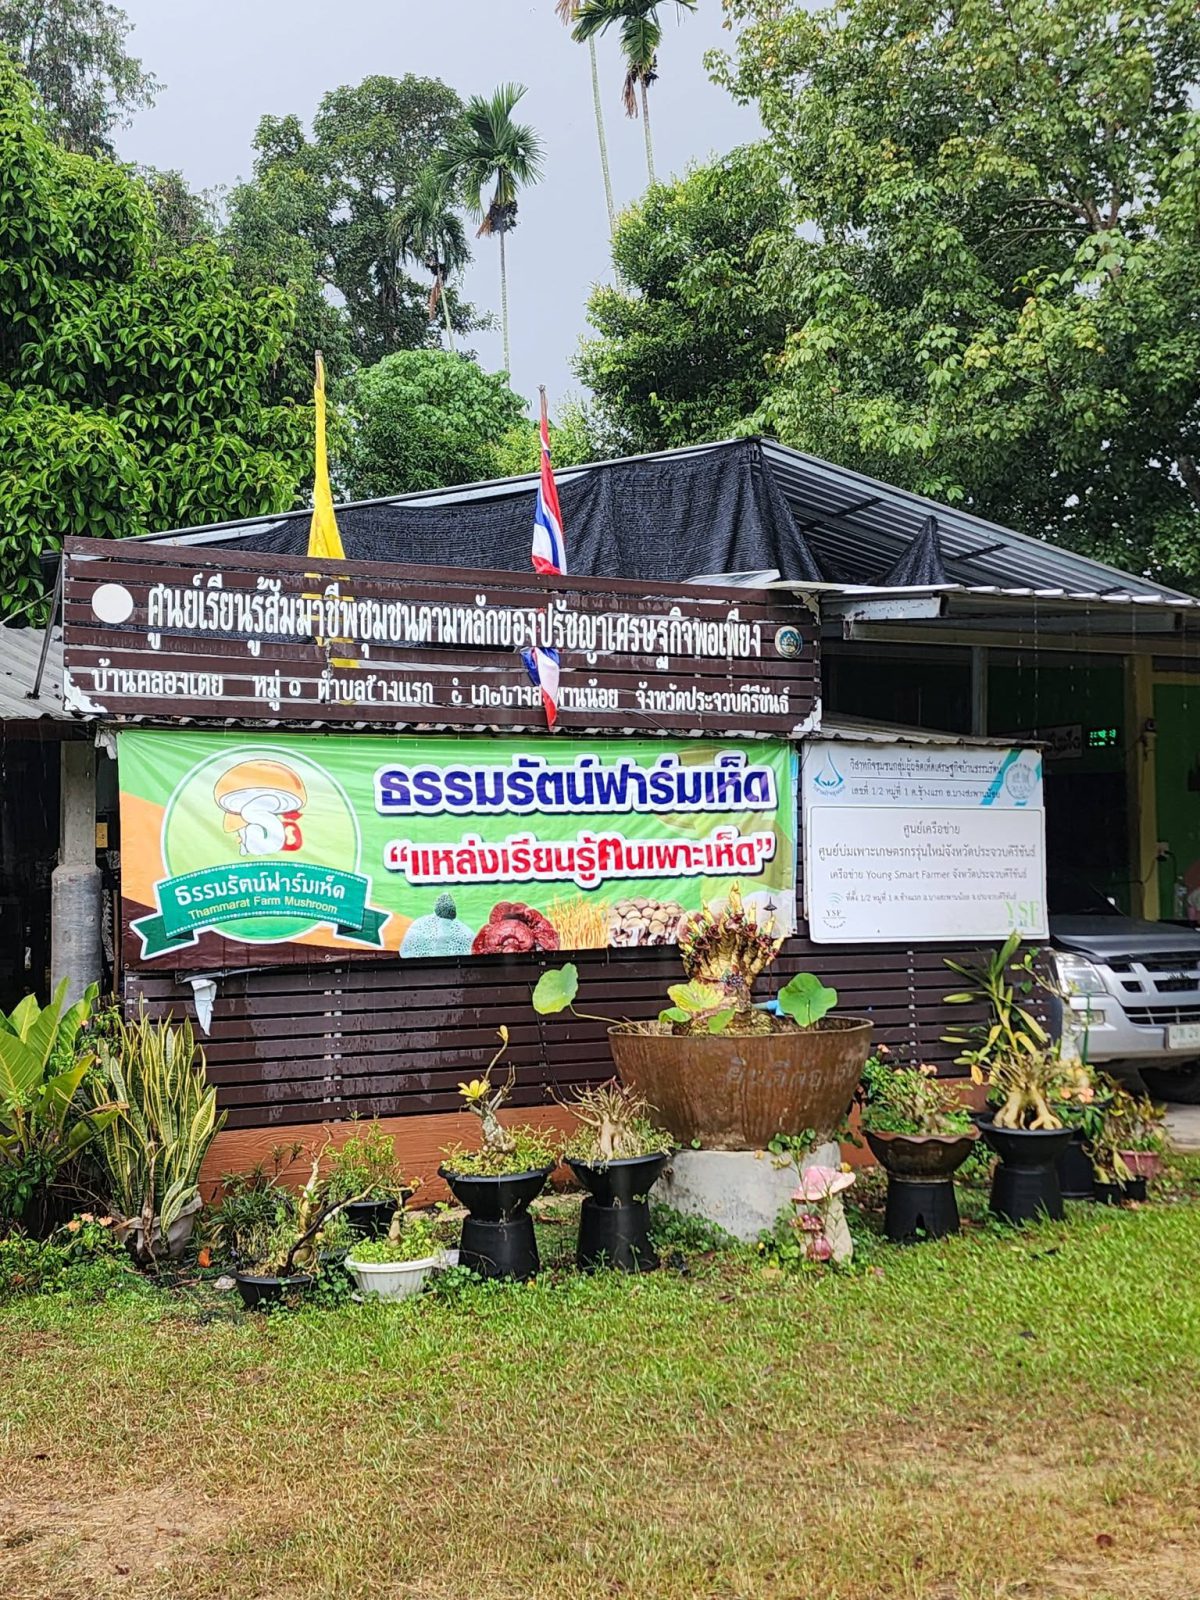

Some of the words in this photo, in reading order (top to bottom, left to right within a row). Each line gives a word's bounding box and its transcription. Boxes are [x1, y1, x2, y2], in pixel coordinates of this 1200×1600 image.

[91, 658, 224, 697] บ้านคลองเตย
[252, 669, 281, 711] หมู่
[635, 681, 790, 714] จังหวัดประจวบคีรีขันธ์
[380, 754, 773, 806] ธรรมรัตน์ฟาร์มเห็ด
[903, 820, 960, 838] ศูนย์เครือข่าย
[174, 871, 345, 906] ธรรมรัตน์ฟาร์มเห็ด
[830, 867, 864, 879] เครือข่าย
[866, 870, 892, 881] Young
[894, 870, 919, 879] Smart
[921, 870, 950, 879] Farmer
[187, 899, 250, 920] Thammarat
[253, 895, 281, 906] Farm
[284, 895, 338, 914] Mushroom
